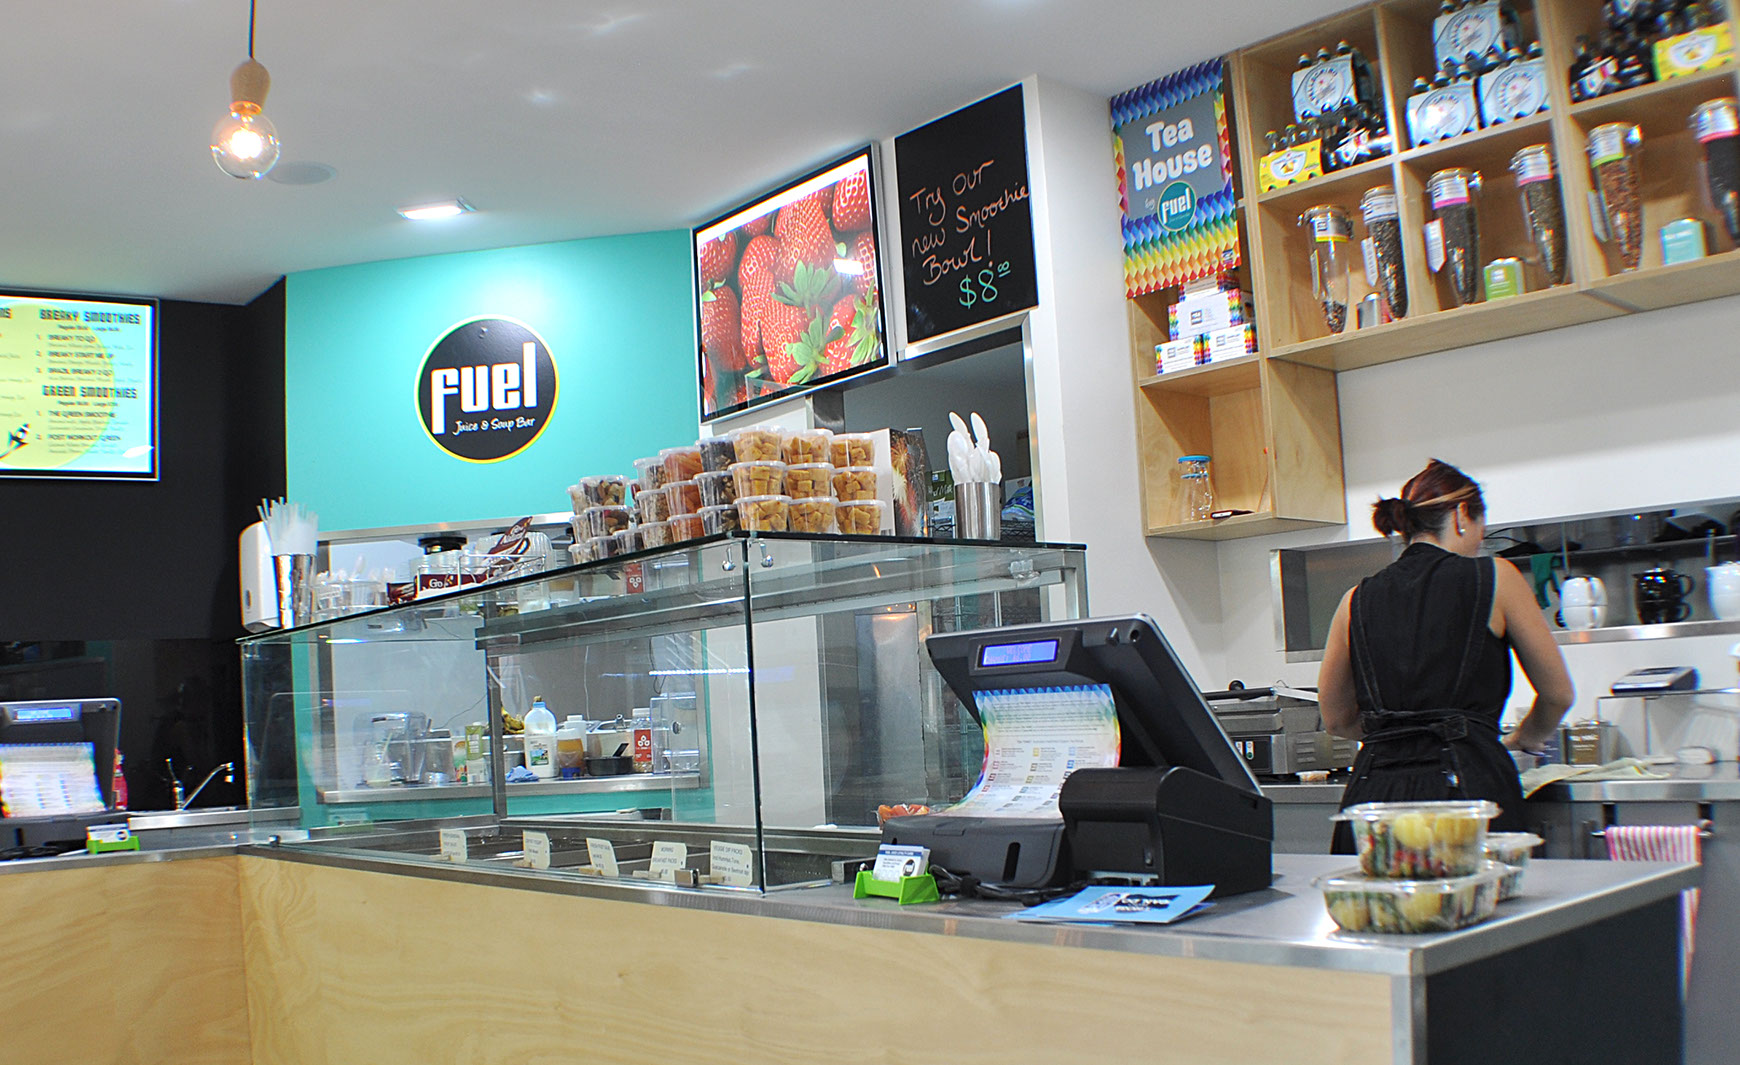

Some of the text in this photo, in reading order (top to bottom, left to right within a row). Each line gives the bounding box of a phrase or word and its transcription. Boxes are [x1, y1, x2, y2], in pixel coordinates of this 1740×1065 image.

[1146, 117, 1194, 152] Tea
[1132, 143, 1213, 191] House
[910, 187, 946, 226] Try
[912, 227, 946, 257] new
[40, 309, 141, 324] BREAKY SMOOTHIES
[43, 385, 137, 399] GREEN SMOOTHIES
[452, 419, 479, 435] Juice
[490, 417, 515, 432] Soup
[515, 416, 536, 429] Bar
